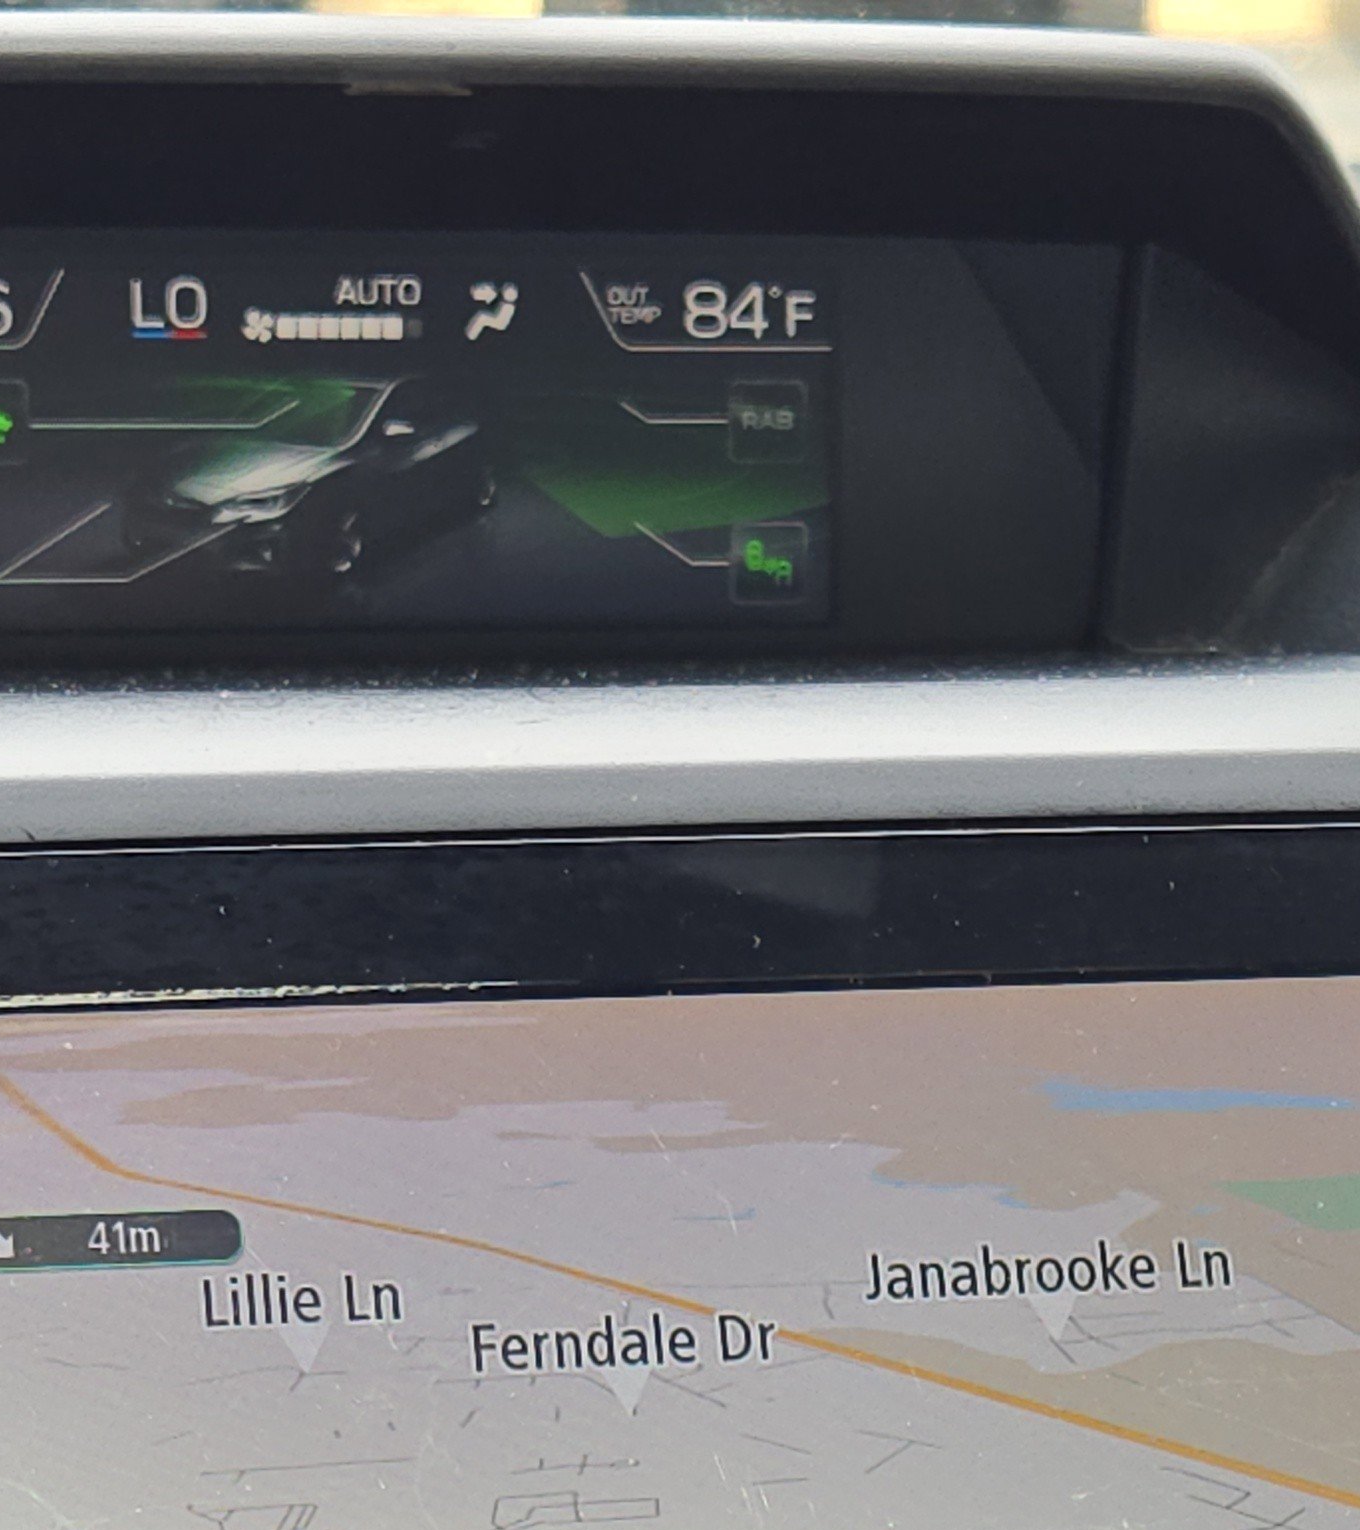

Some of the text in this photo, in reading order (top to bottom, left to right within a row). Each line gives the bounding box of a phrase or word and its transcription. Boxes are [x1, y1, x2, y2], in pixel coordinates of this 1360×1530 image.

[130, 274, 209, 330] LO
[335, 276, 422, 306] AUTO
[607, 285, 649, 305] OUT
[607, 305, 661, 326] TEMP
[87, 1221, 161, 1256] 41m
[865, 1242, 1232, 1302] Janabrooke Ln
[202, 1274, 402, 1328] Lillie Ln
[472, 1313, 775, 1372] Ferndale Dr
